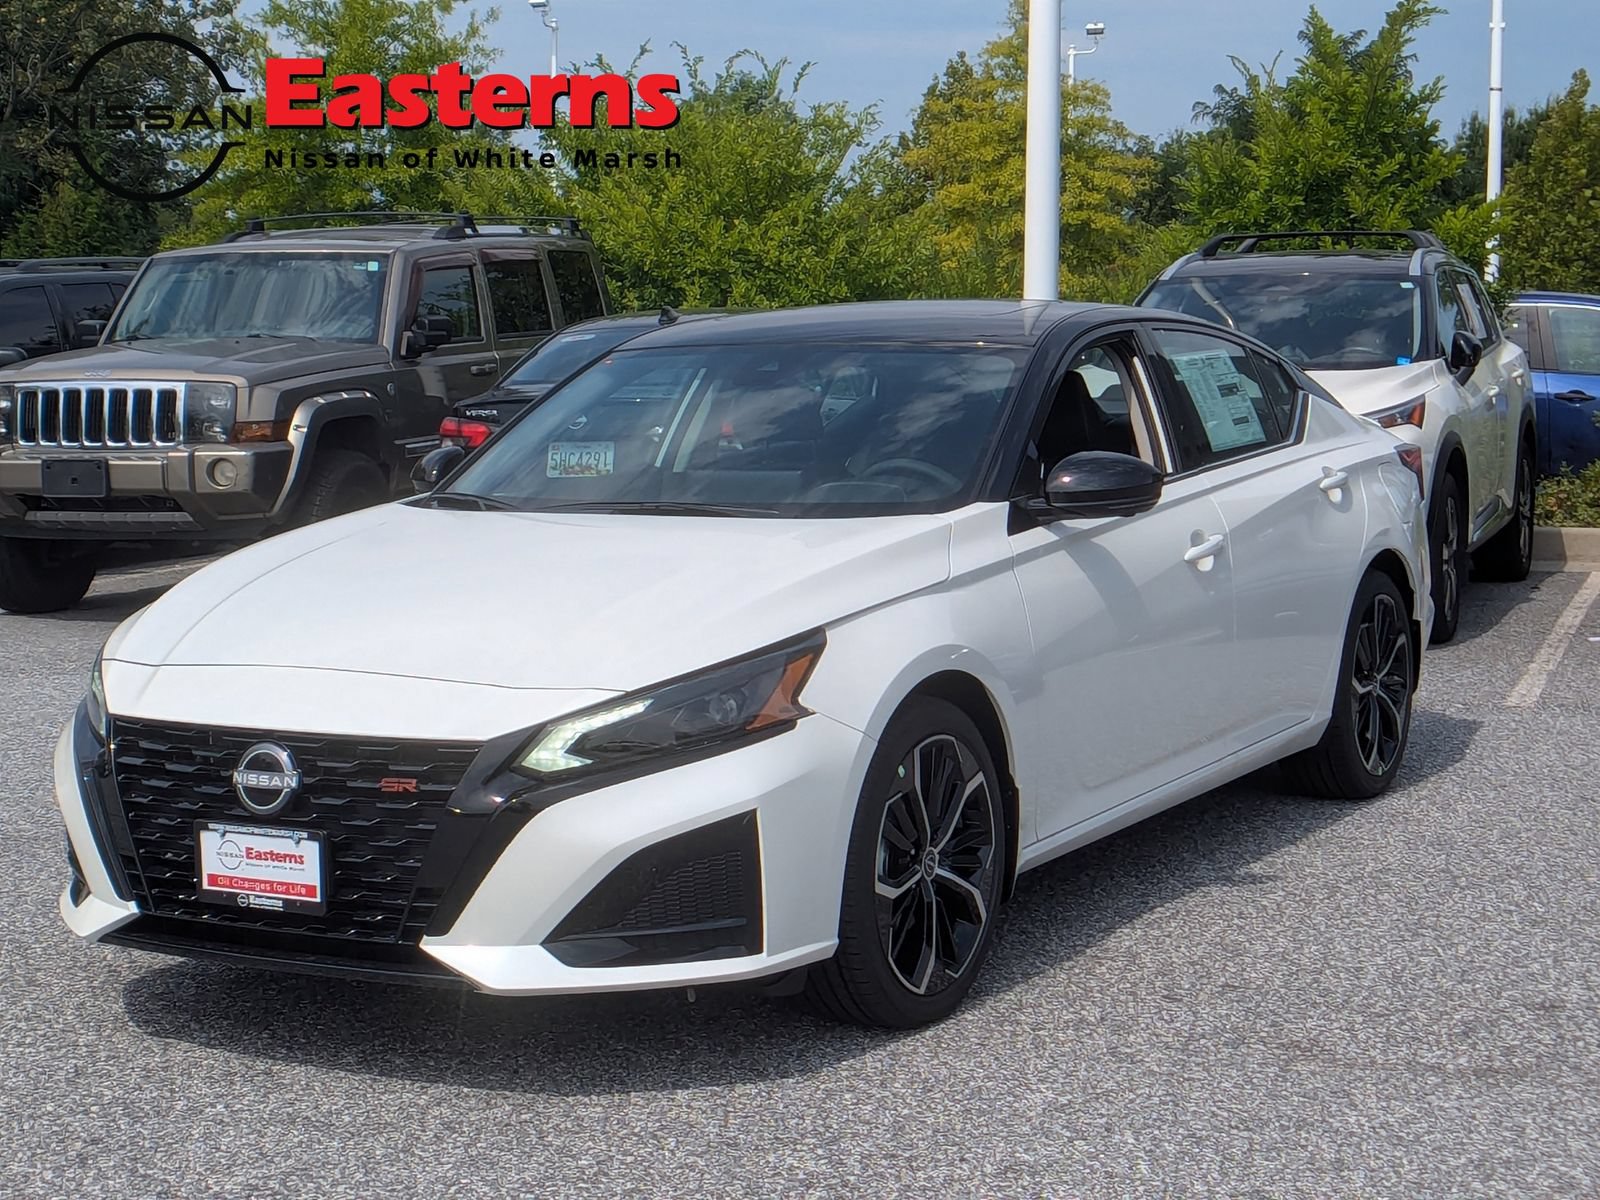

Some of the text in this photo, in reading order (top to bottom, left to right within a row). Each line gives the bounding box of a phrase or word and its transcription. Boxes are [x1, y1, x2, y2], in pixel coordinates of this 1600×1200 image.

[232, 771, 299, 787] NISSAN
[377, 777, 420, 793] SR
[245, 846, 305, 865] Easterns
[217, 876, 306, 895] Oil Changes for Life
